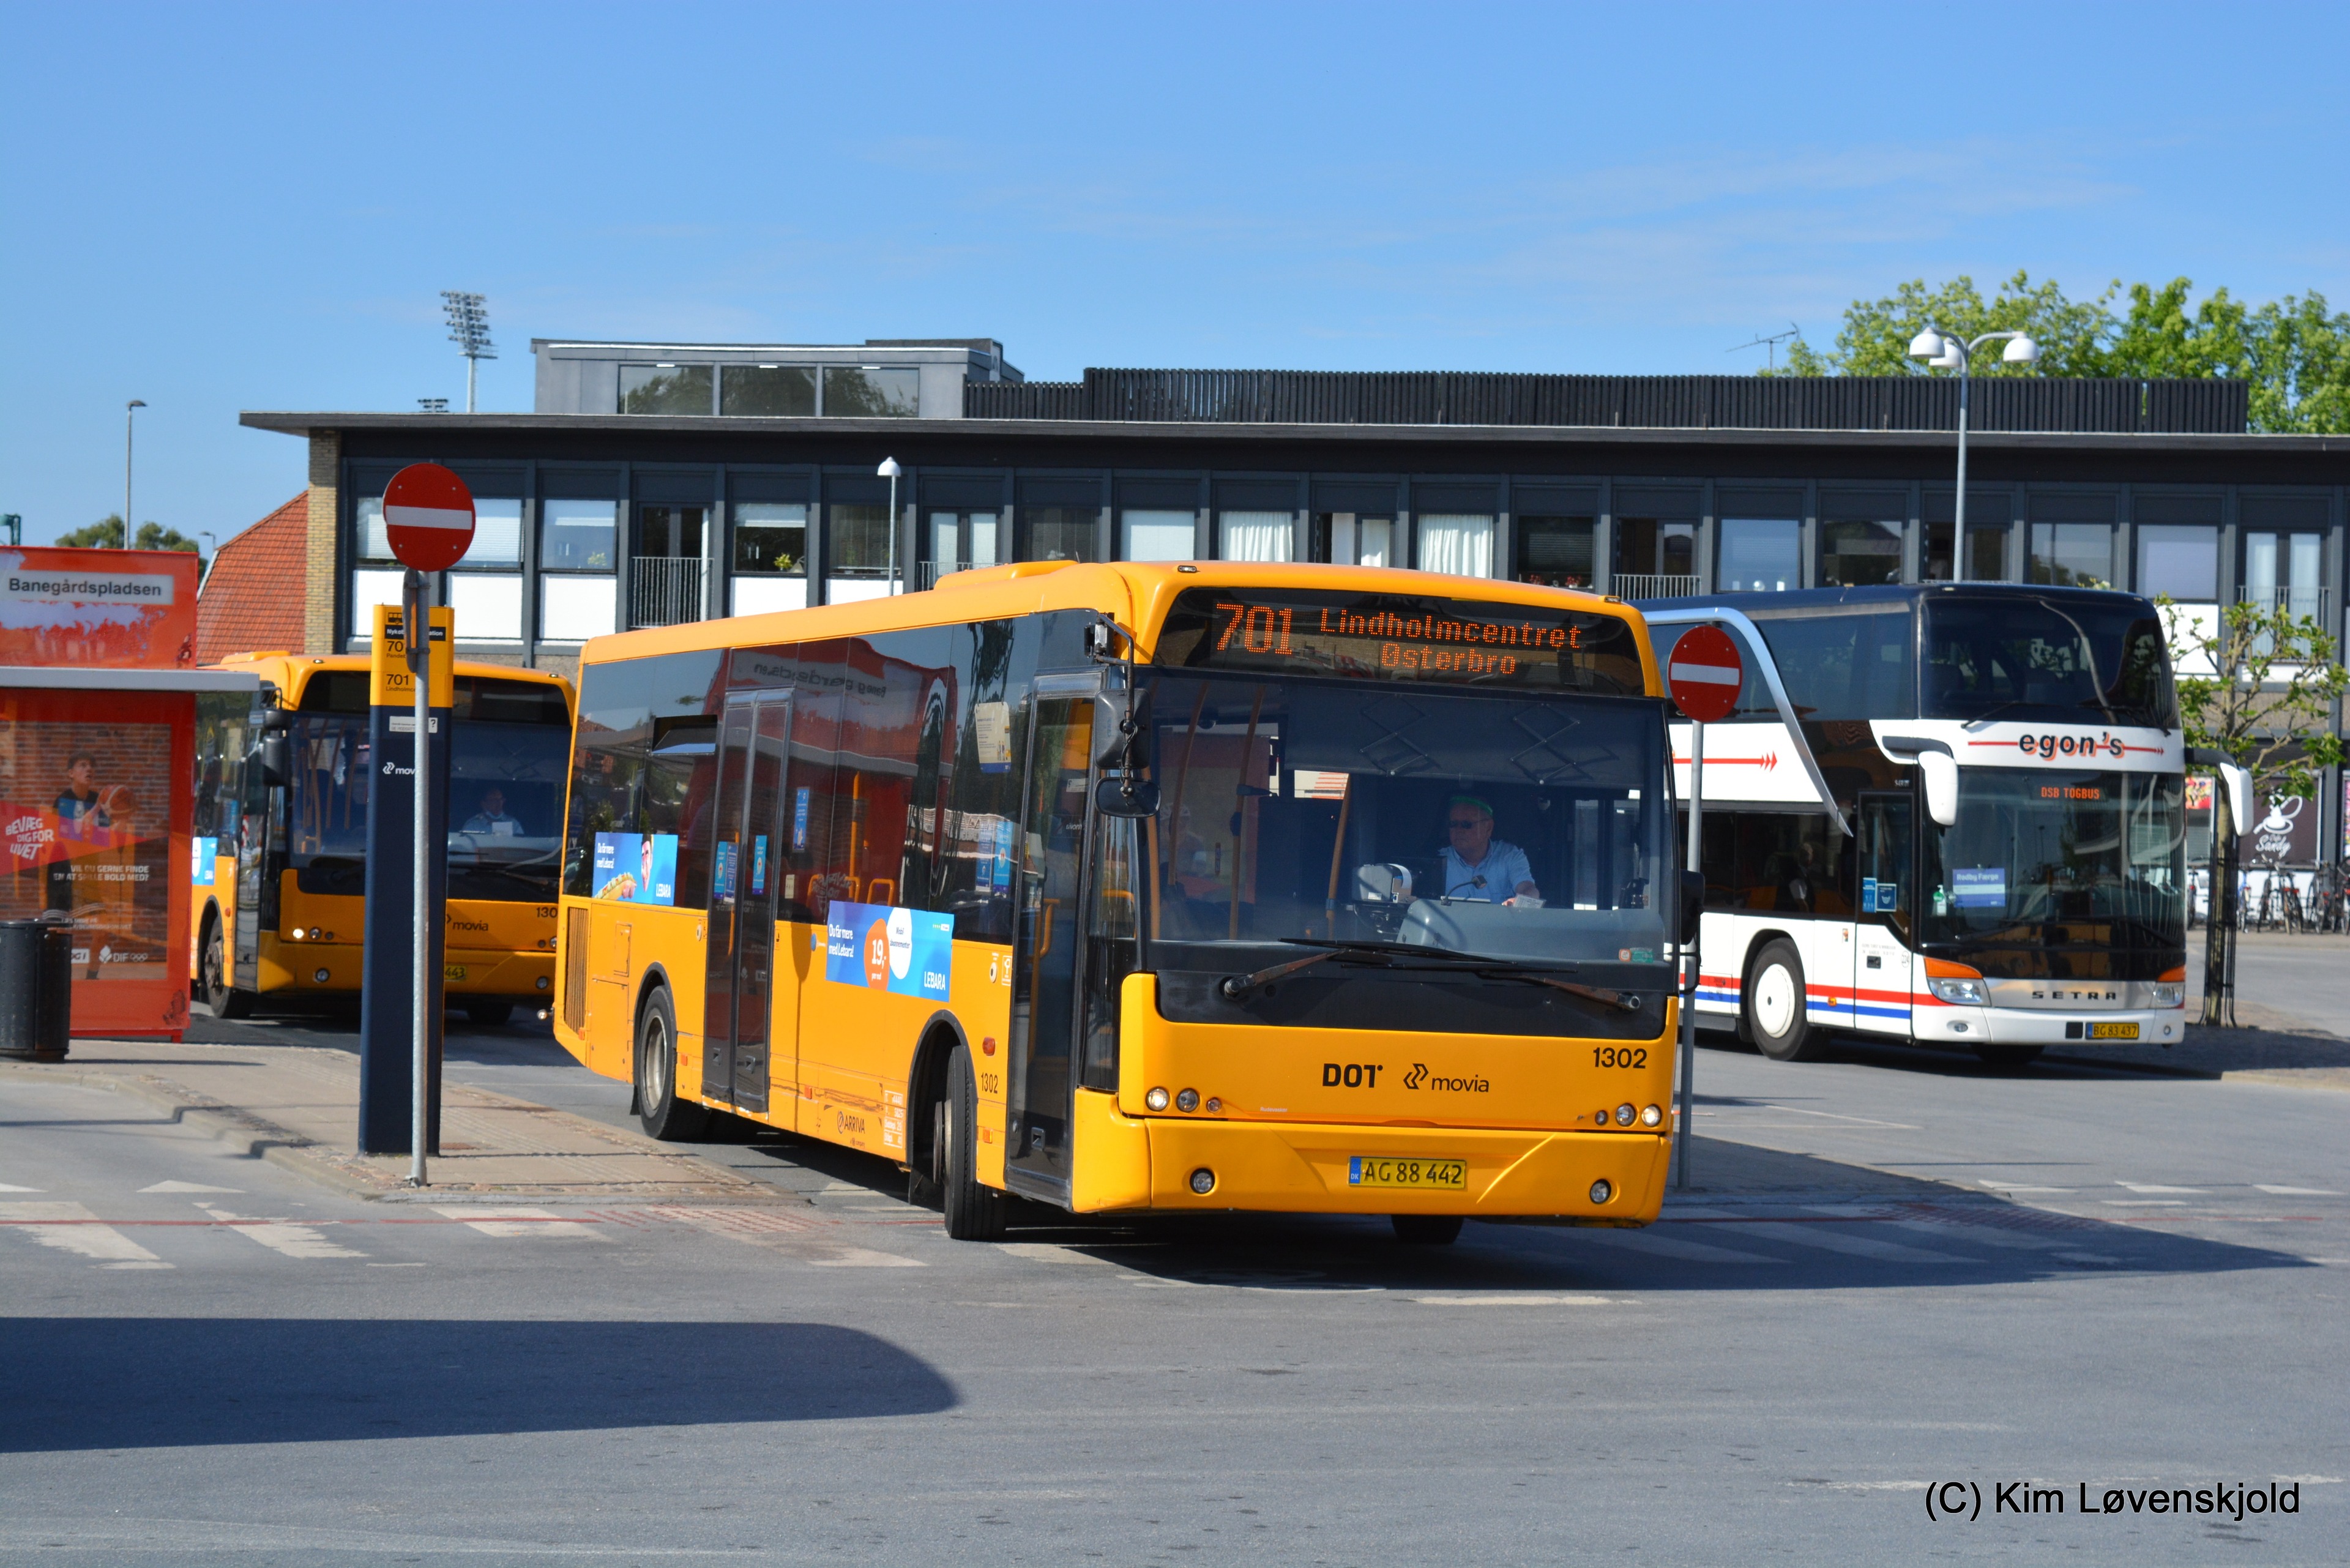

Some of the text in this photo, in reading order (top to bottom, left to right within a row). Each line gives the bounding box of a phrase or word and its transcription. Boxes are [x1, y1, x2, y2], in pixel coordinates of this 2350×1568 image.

[9, 578, 162, 597] Banegårdspladsen
[1216, 603, 1581, 655] 701 Lindholmcentret
[387, 641, 404, 652] 70
[1381, 643, 1516, 674] Østerbro
[386, 674, 409, 685] 701
[2019, 731, 2125, 761] egon's
[2041, 787, 2100, 800] DSB TOGBUS
[6, 816, 43, 836] BEVÆG
[17, 829, 54, 843] DIG FOR
[10, 843, 43, 861] LIVET
[125, 865, 150, 873] FINDE
[127, 873, 150, 882] MED?
[655, 883, 672, 898] LEBARA
[537, 906, 558, 918] 130
[452, 920, 489, 931] movia
[829, 924, 835, 937] Du
[842, 929, 854, 939] mere
[113, 952, 130, 963] DIF
[828, 943, 838, 956] med
[838, 944, 854, 958] Lebara!
[924, 971, 946, 991] LEBARA
[2032, 991, 2116, 1000] SETRA
[1593, 1047, 1647, 1069] 1302
[981, 1072, 998, 1094] 1302
[1322, 1063, 1490, 1092] DOT movia
[845, 1114, 865, 1134] ARRIVA
[1364, 1162, 1390, 1181] AG
[1396, 1162, 1420, 1182] 88
[1425, 1163, 1462, 1184] 442
